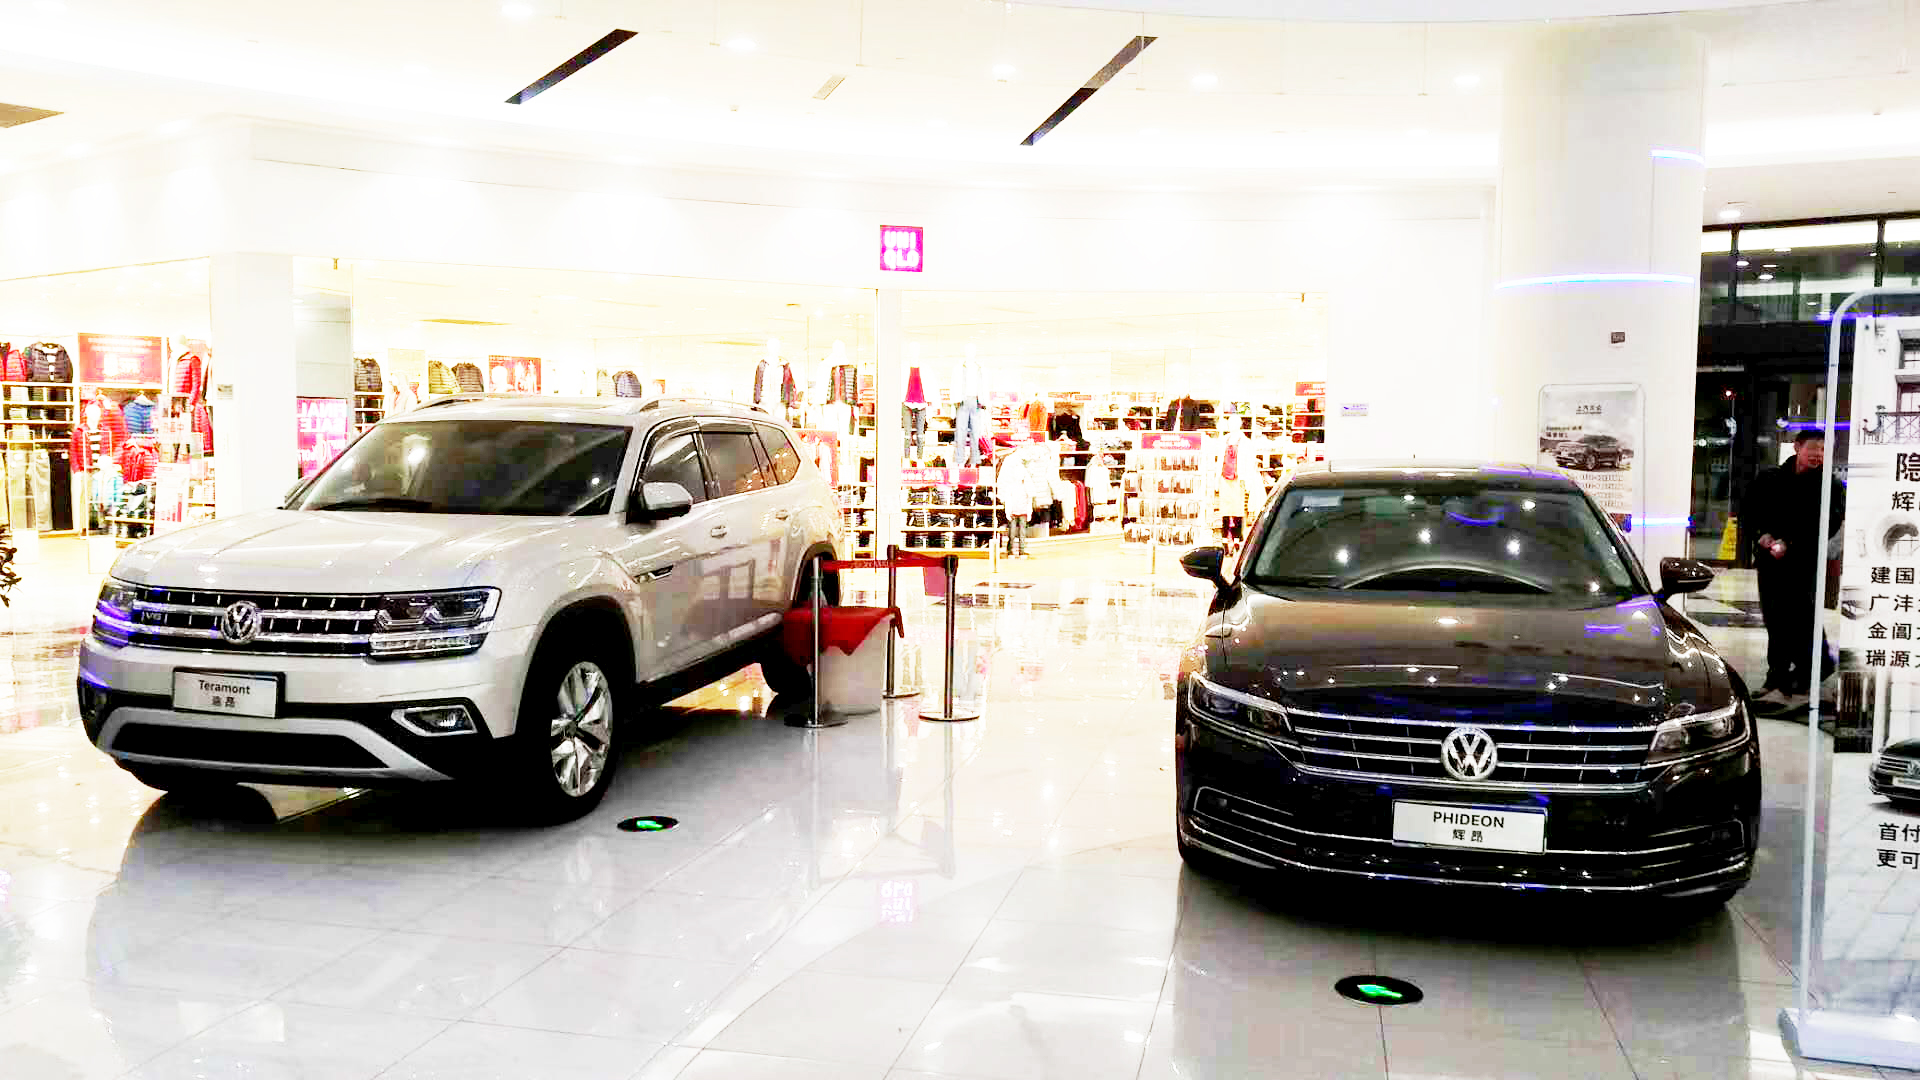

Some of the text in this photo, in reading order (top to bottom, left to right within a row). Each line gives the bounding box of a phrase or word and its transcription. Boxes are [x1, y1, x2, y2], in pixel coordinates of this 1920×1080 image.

[1892, 491, 1920, 511] 辉
[1869, 594, 1920, 612] 广沣
[1867, 622, 1920, 640] 金阊
[1865, 649, 1920, 668] 瑞源
[198, 679, 251, 695] Teramont
[1433, 811, 1505, 829] PHIDEON
